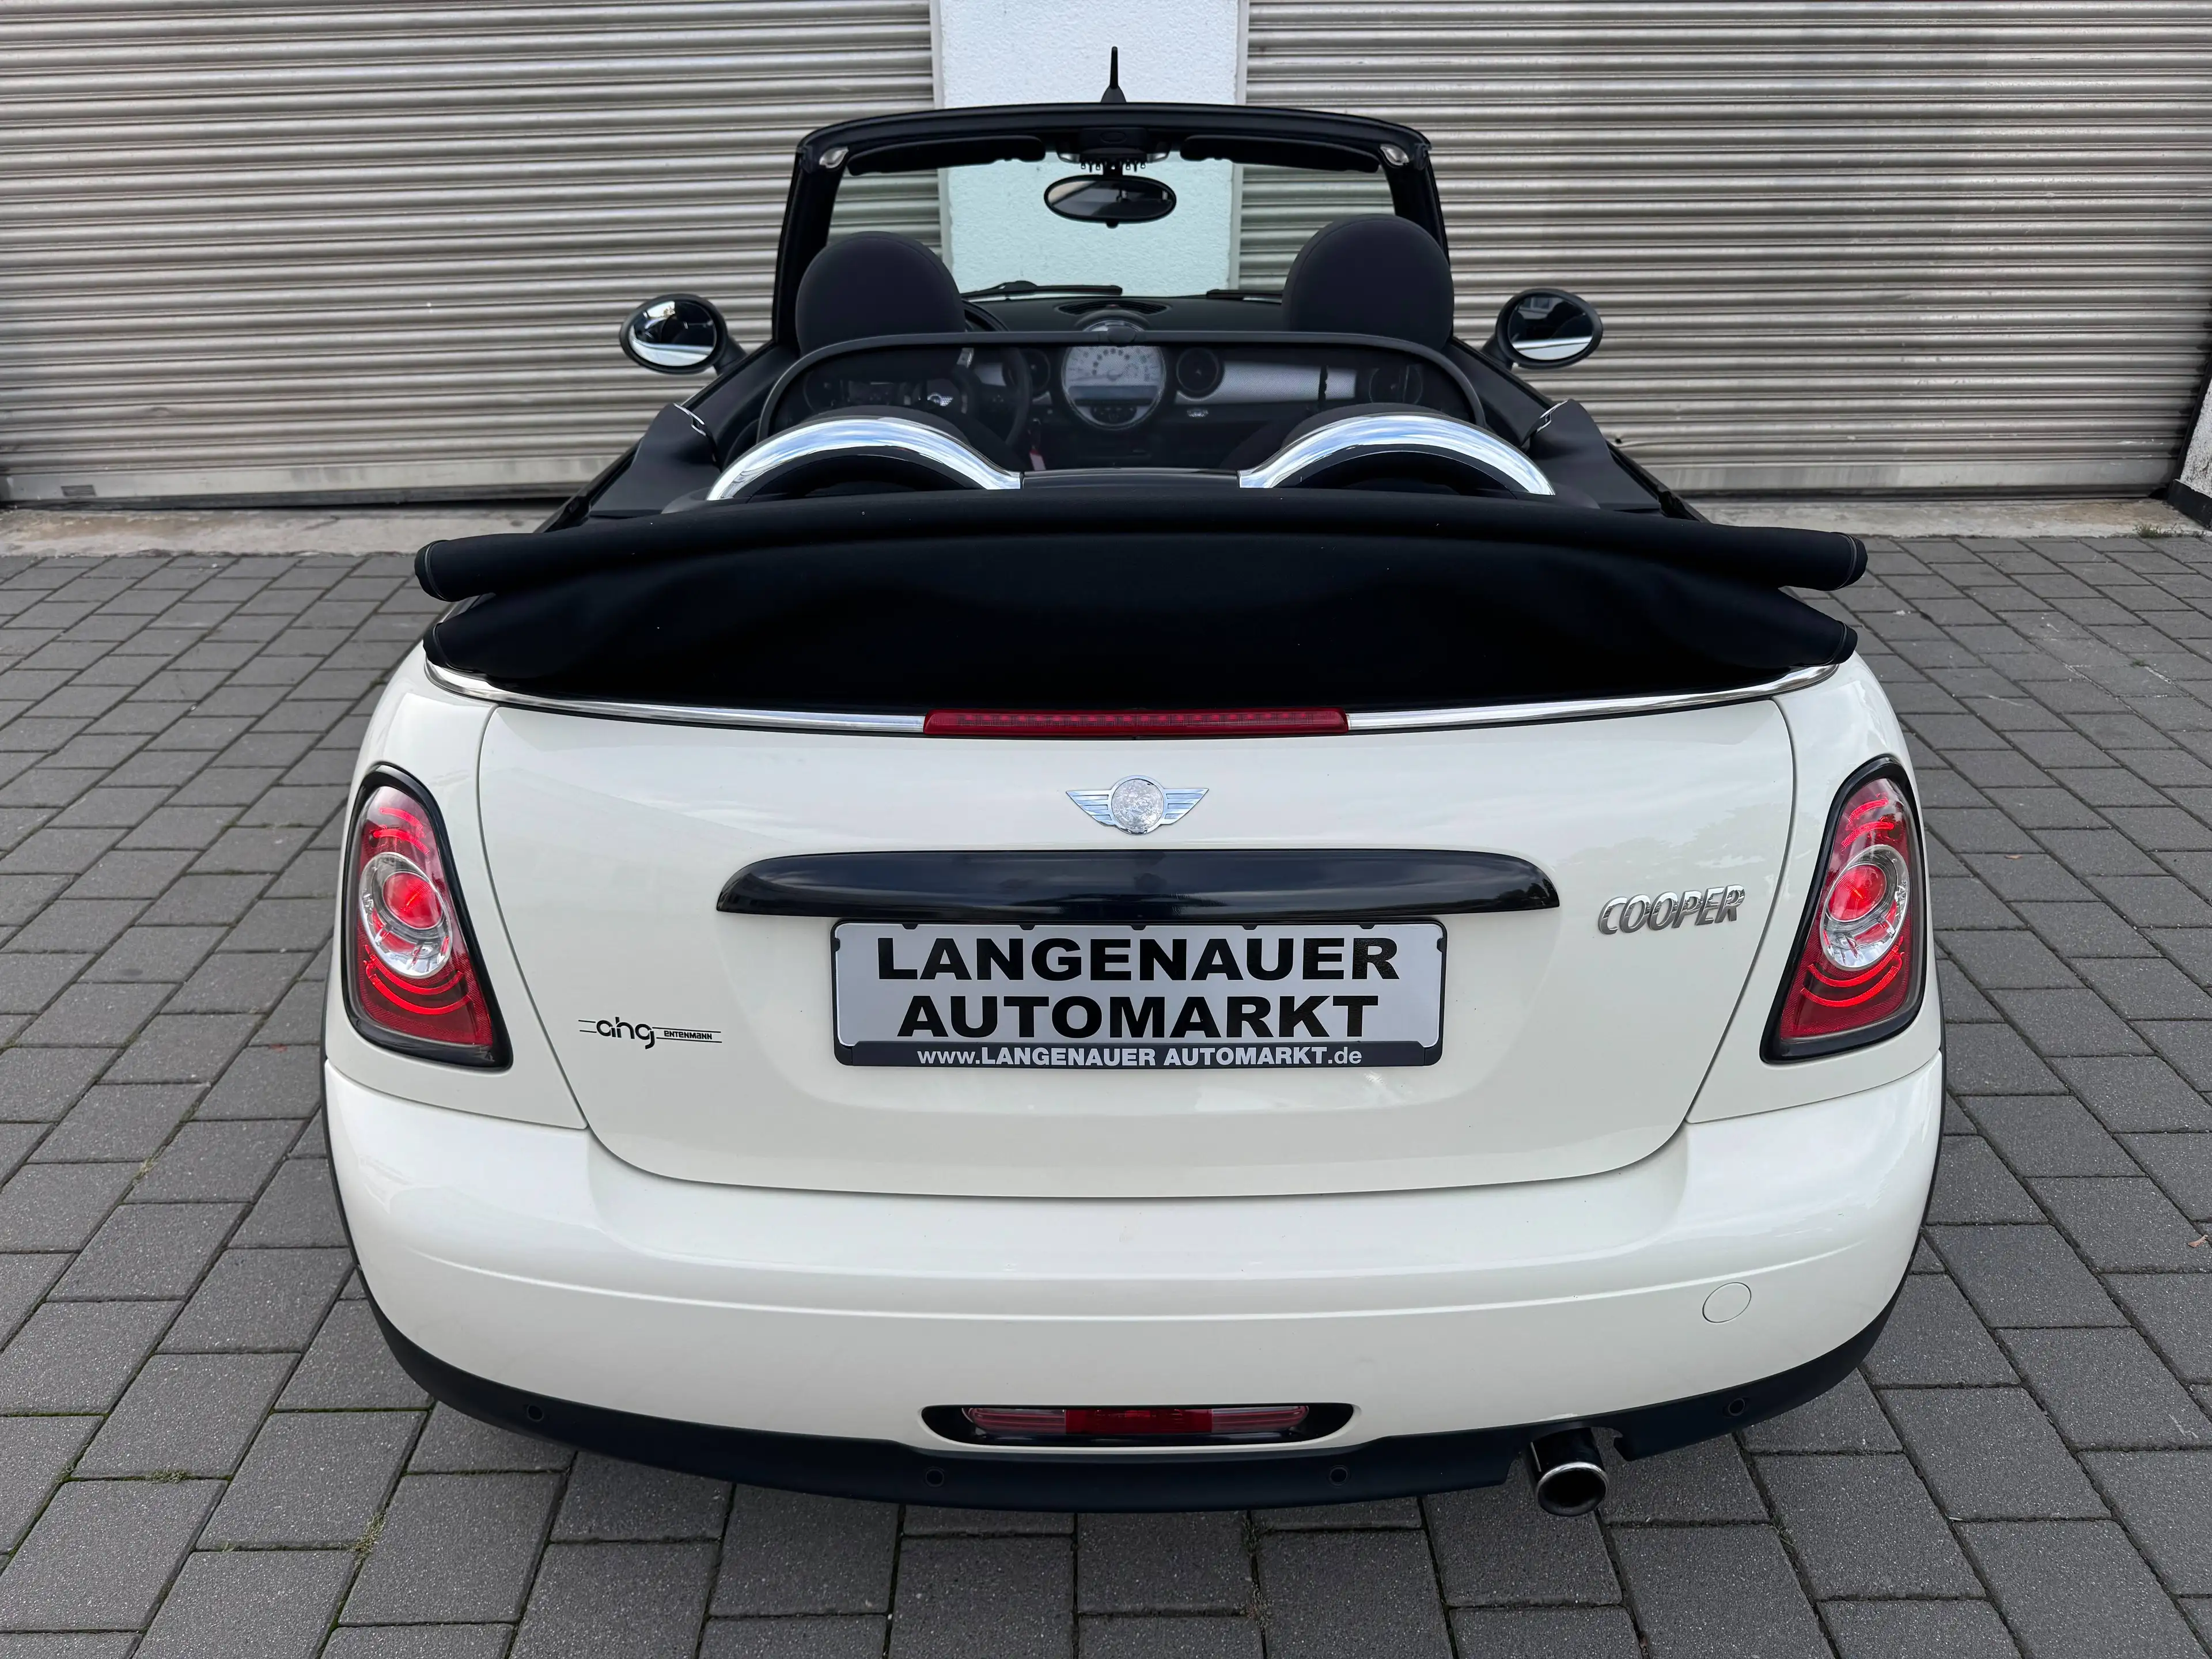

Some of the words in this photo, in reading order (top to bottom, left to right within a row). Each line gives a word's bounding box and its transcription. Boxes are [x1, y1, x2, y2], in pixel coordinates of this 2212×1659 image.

[1598, 884, 1746, 935] COOPER
[878, 938, 1400, 981] LANGENAUER
[596, 1016, 655, 1050] ahg
[897, 996, 1378, 1038] AUTOMARKT
[917, 1047, 1156, 1066] www.LANGENAUER
[1164, 1047, 1363, 1066] AUTOMARKT.de
